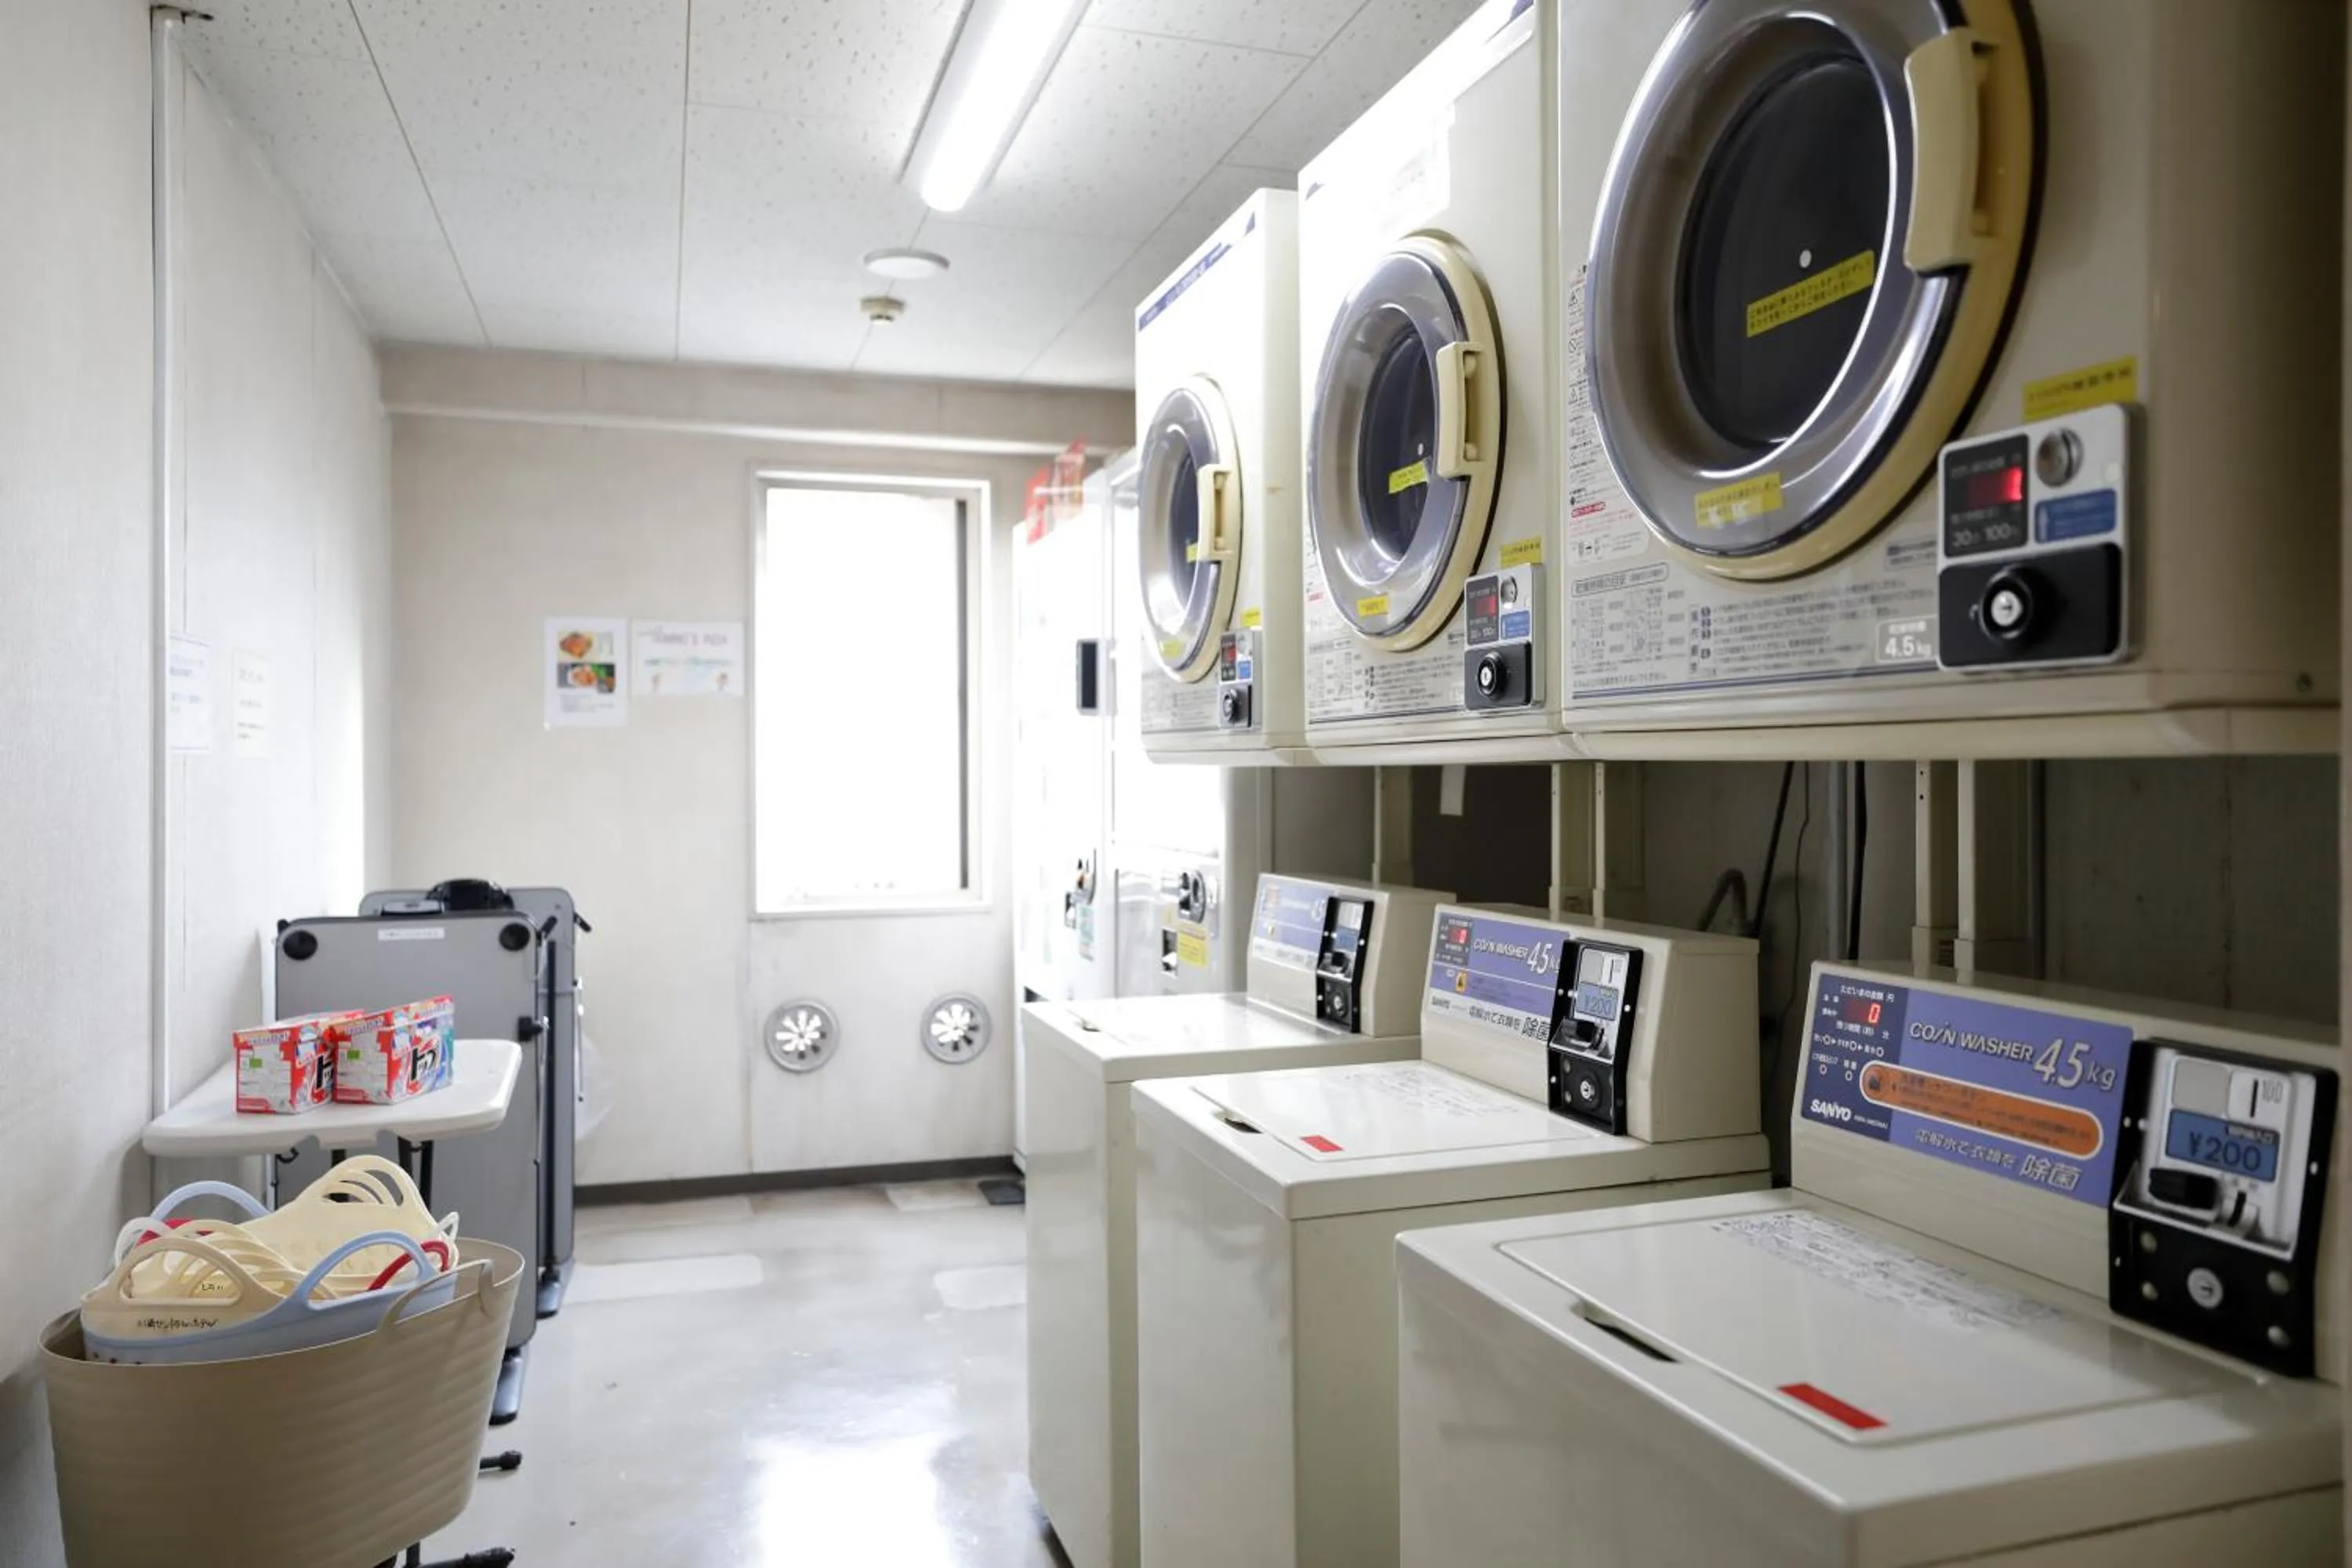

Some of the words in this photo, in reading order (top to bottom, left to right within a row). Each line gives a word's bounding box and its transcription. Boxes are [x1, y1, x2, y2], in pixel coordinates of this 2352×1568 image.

[1868, 1003, 1881, 1024] 0
[1960, 1032, 2034, 1061] WASHER
[1810, 1098, 1852, 1121] SANYO
[2189, 1131, 2261, 1173] ¥200
[2020, 1153, 2083, 1191] 除菌
